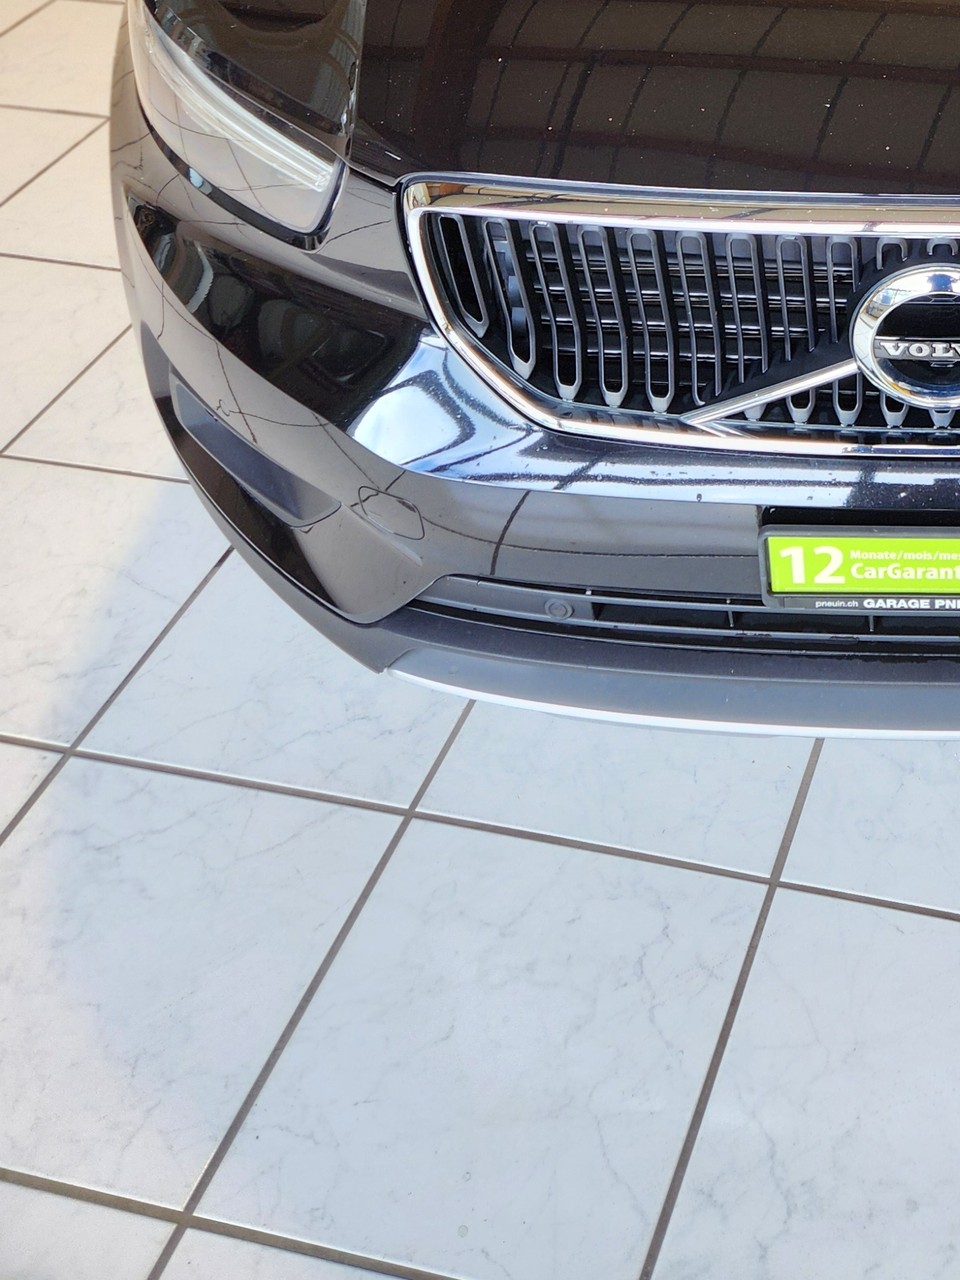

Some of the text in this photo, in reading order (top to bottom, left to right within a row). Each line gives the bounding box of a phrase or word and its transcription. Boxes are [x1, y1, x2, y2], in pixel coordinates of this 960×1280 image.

[779, 545, 846, 585] 12
[815, 600, 859, 609] pneuin.ch
[863, 599, 931, 609] GARAGE
